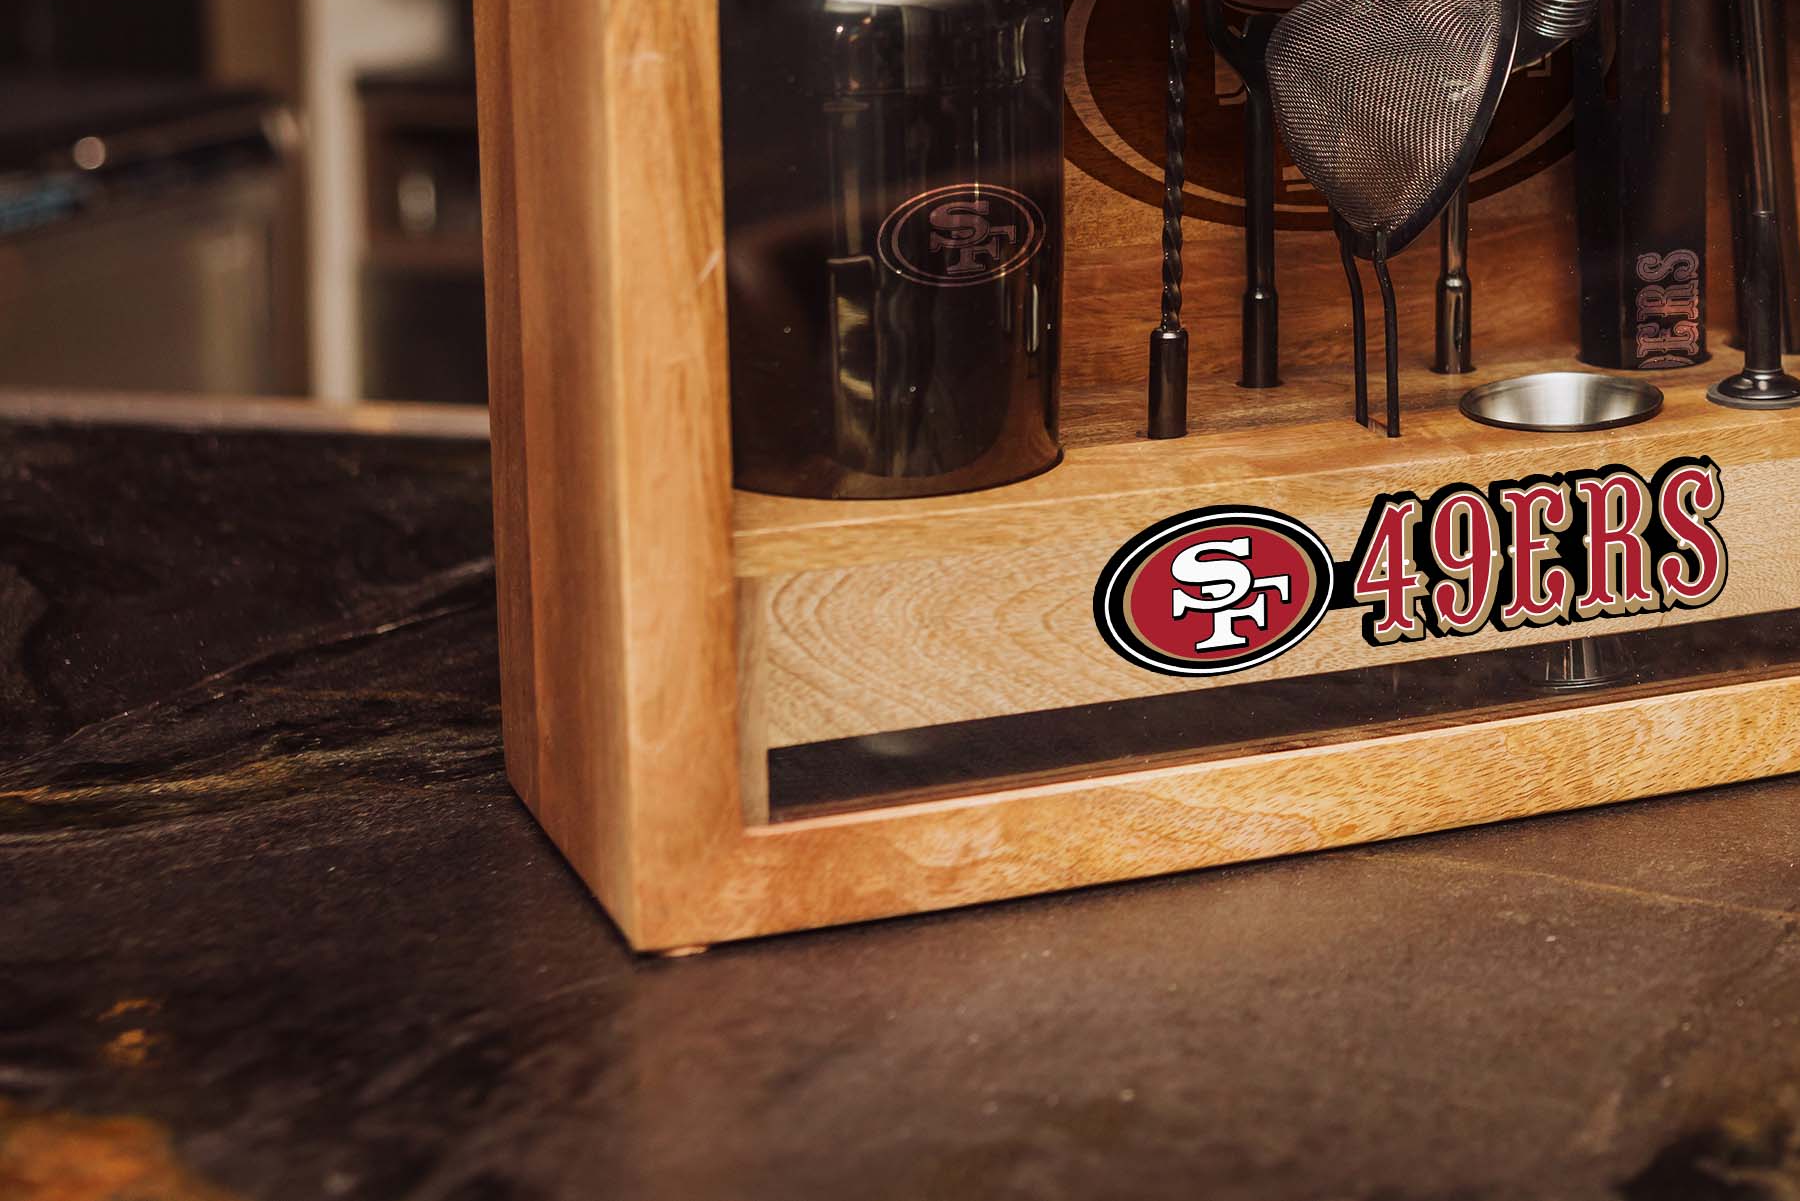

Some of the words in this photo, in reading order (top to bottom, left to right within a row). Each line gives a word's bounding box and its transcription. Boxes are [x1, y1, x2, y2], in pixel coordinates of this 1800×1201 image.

[929, 200, 1017, 274] SF
[1635, 249, 1699, 369] ERS
[1171, 536, 1290, 651] SF
[1353, 462, 1723, 639] 49ERS
